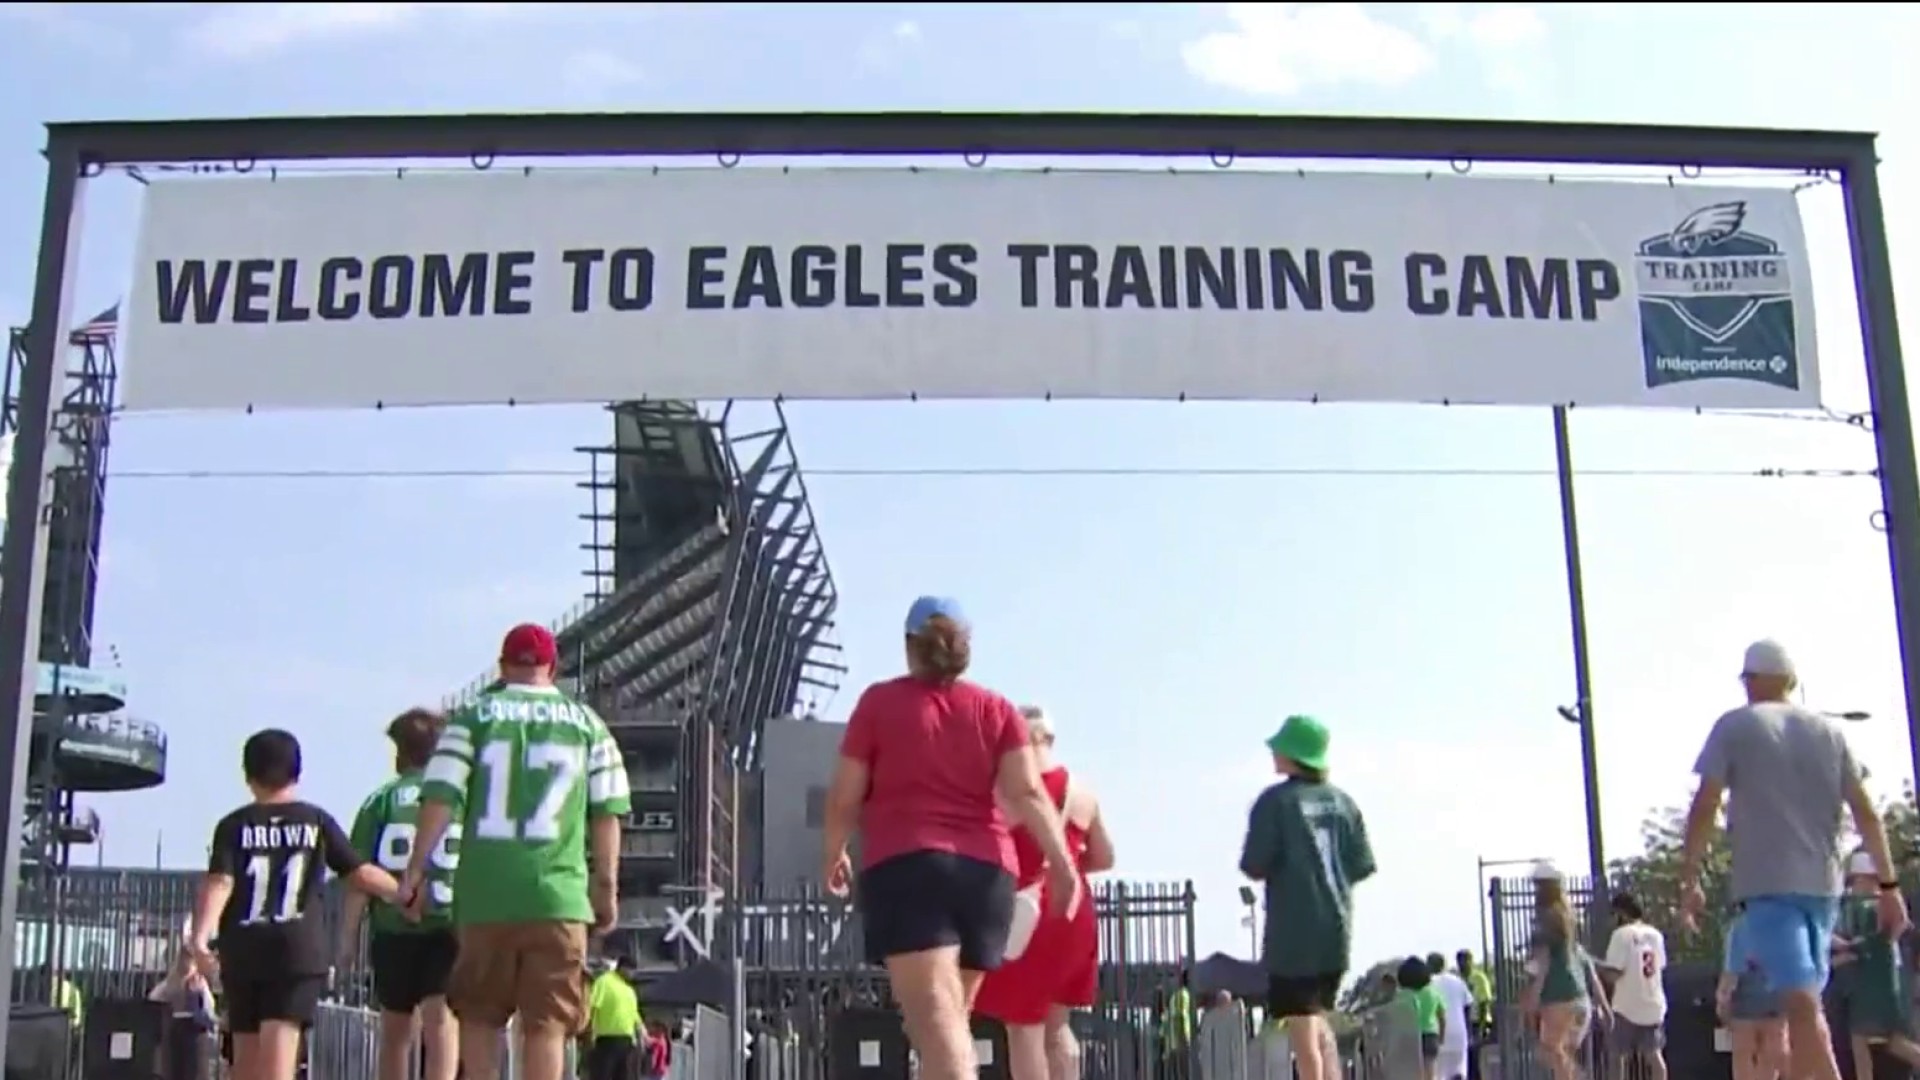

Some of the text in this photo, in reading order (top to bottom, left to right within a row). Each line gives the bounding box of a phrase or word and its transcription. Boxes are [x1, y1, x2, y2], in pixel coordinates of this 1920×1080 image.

[156, 244, 1622, 324] WELCOME TO EAGLES TRAINING CAMP
[1645, 260, 1778, 280] TRAINING
[1656, 354, 1767, 374] Independence
[476, 738, 586, 840] 17
[241, 822, 319, 849] BROWN
[239, 852, 306, 925] 11
